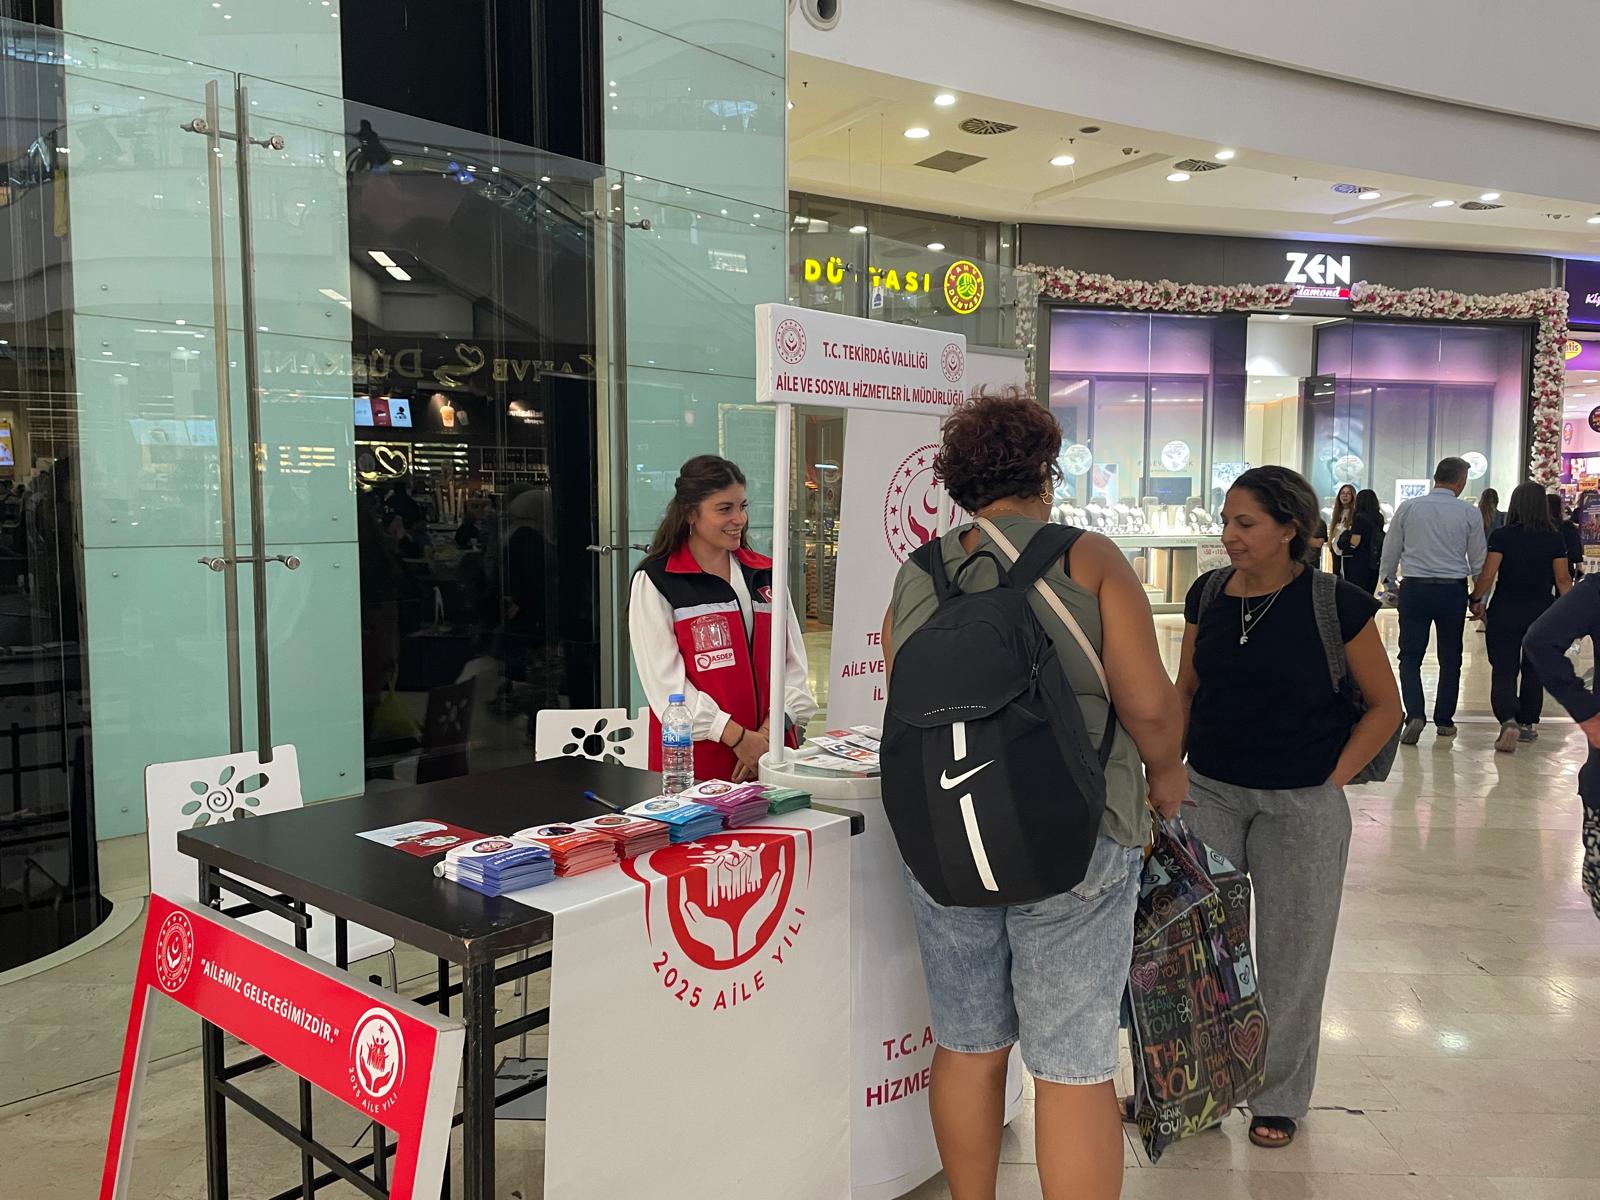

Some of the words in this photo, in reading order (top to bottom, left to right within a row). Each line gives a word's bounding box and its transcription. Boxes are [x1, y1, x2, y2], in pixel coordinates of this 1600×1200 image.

[804, 257, 931, 293] DÜYASI
[1284, 252, 1351, 285] ZEN
[948, 288, 981, 310] DÜNYASI
[823, 341, 841, 359] T.C.
[843, 343, 890, 364] TEKİRDAĞ
[890, 350, 928, 370] VALİLİĞİ
[776, 371, 800, 392] AİLE
[800, 377, 814, 393] VE
[815, 378, 851, 397] SOSYAL
[853, 380, 902, 401] HİZMETLER
[903, 384, 911, 402] İL
[912, 384, 964, 406] MÜDÜRLÜĞÜ
[867, 632, 883, 646] TE
[712, 652, 733, 661] ASDEP
[841, 663, 866, 678] AİLE
[868, 660, 884, 674] VE
[873, 686, 884, 701] İL
[652, 951, 702, 1008] 2025
[713, 969, 765, 1011] AİLE
[771, 907, 806, 964] YILI
[200, 958, 241, 994] "AİLEMİZ
[243, 981, 339, 1044] GELECEĞİMİZDİR."
[883, 1033, 917, 1061] T.C.
[348, 1066, 361, 1098] 2025
[361, 1098, 380, 1114] AİLE
[382, 1092, 398, 1112] YILI
